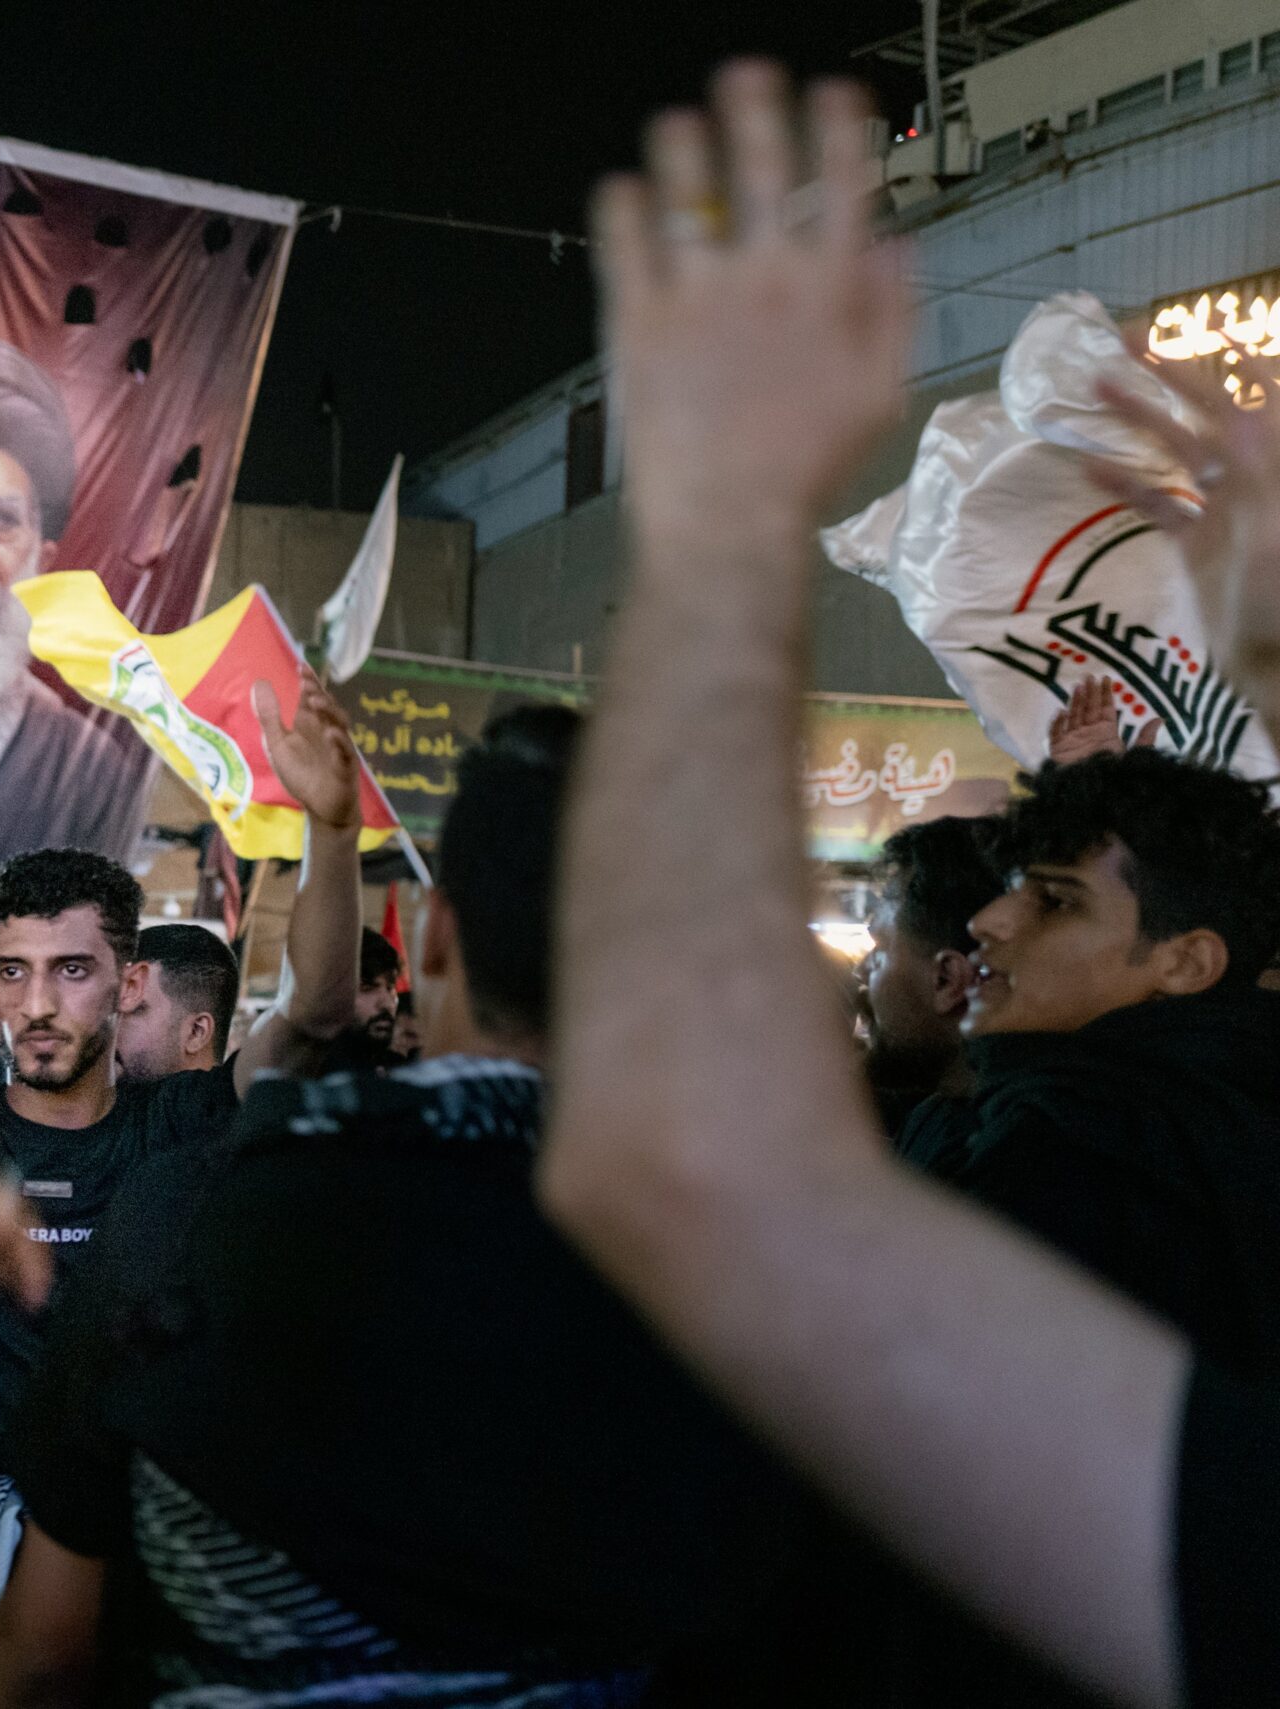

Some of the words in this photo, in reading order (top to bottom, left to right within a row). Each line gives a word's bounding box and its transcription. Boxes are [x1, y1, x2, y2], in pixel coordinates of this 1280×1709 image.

[360, 689, 450, 720] موكب
[26, 1227, 60, 1243] ERA
[60, 1227, 93, 1243] BOY
